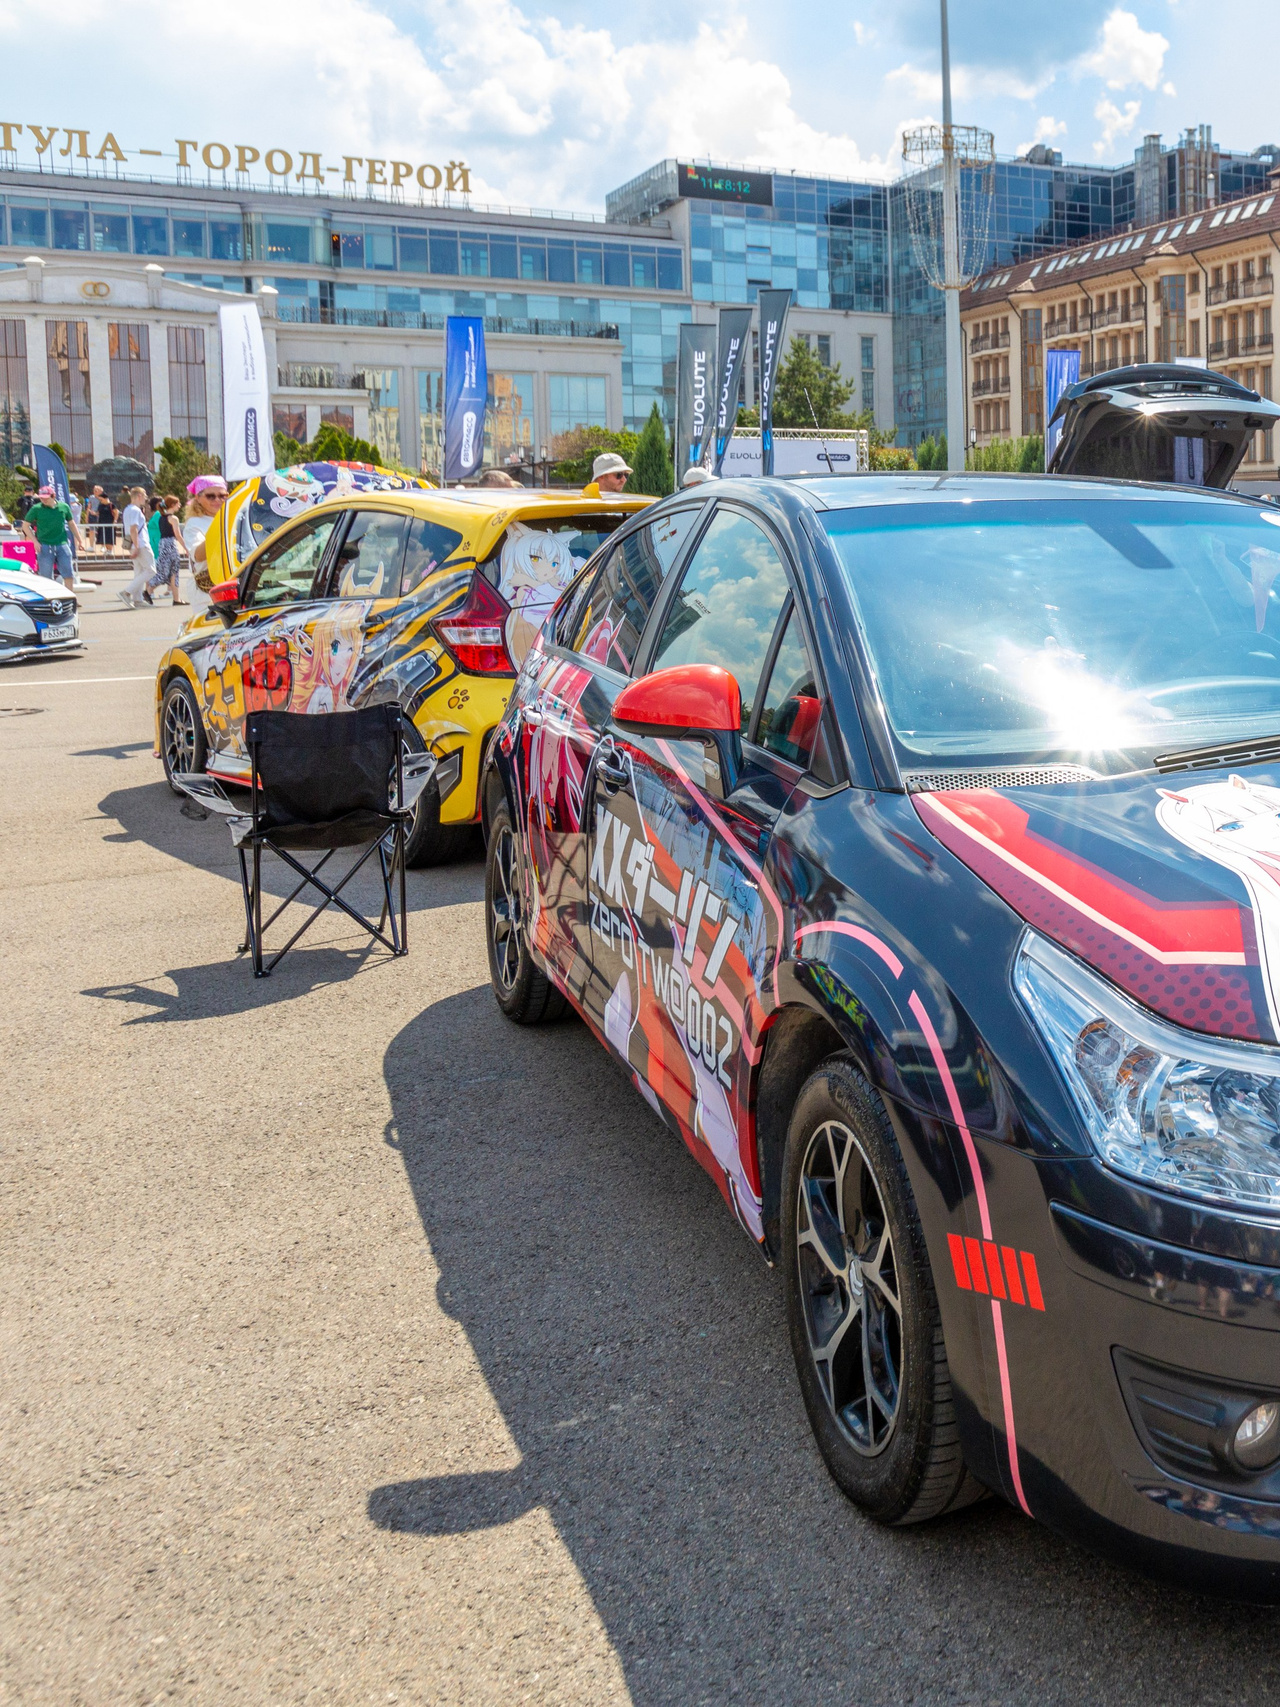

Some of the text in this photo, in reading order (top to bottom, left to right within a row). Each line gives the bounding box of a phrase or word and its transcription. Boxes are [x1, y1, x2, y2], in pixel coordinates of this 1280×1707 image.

[0, 122, 128, 162] ТУЛА
[175, 139, 472, 193] ГОРОД-ГЕРОЙ
[693, 350, 706, 437] EVOLUTE
[247, 412, 257, 463] АВТОКЛАСС
[463, 417, 474, 463] АВТОКЛАСС
[730, 452, 762, 460] EVOLU
